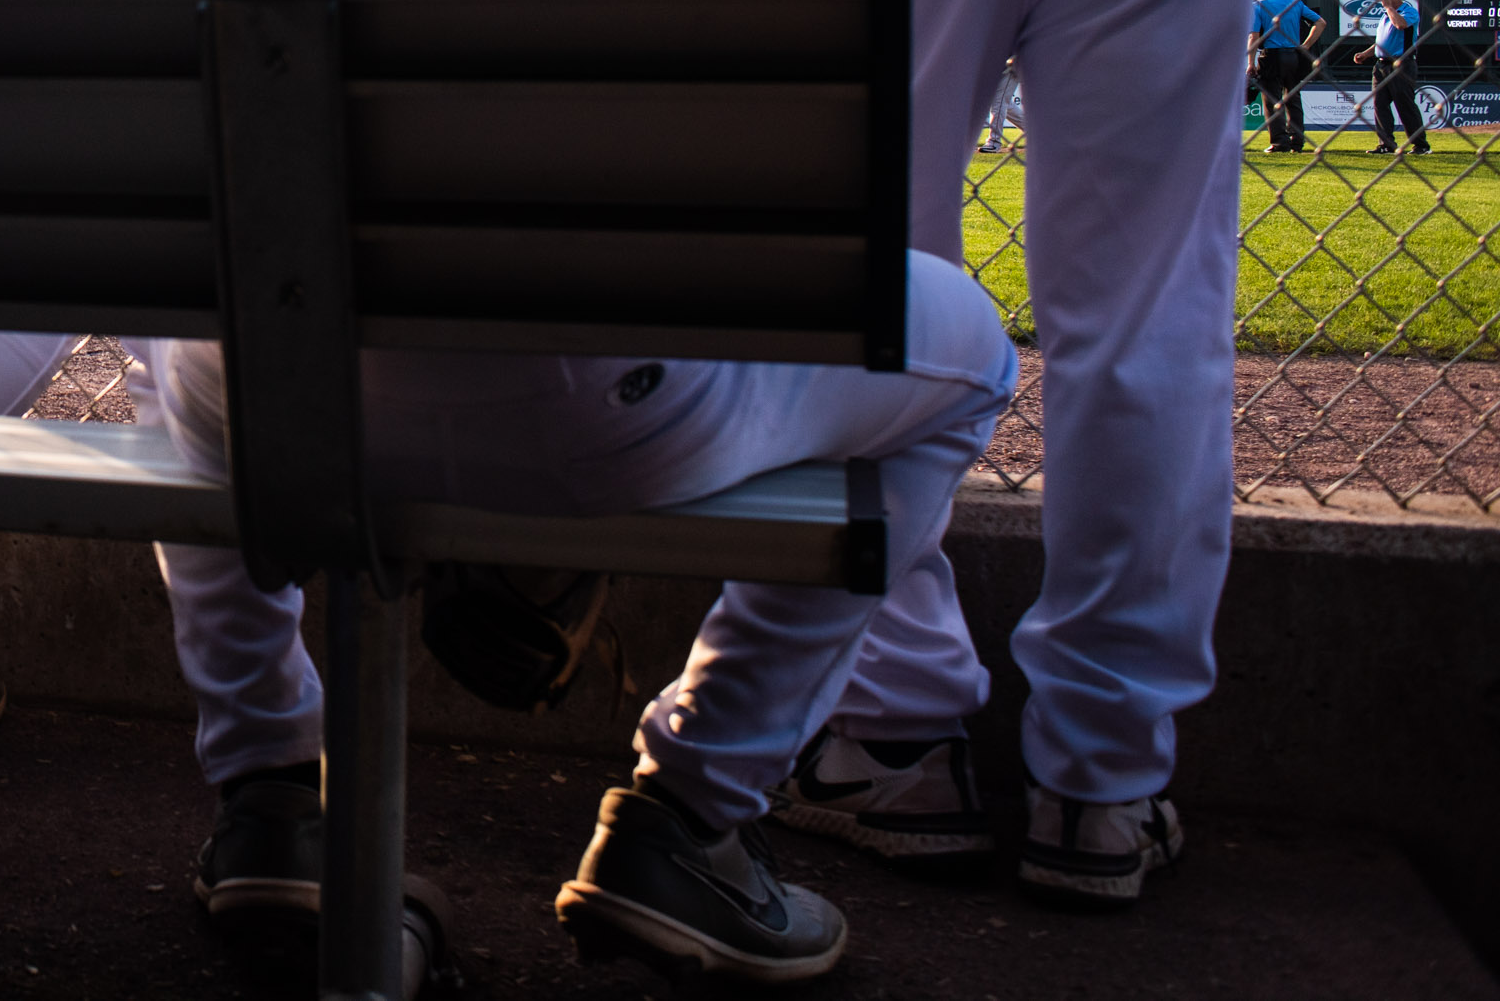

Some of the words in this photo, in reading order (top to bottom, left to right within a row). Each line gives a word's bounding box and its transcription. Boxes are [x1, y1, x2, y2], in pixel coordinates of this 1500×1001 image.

[1489, 8, 1495, 17] 0
[1453, 89, 1500, 101] Vermon
[1452, 103, 1489, 114] Paint
[1452, 116, 1500, 127] Compa
